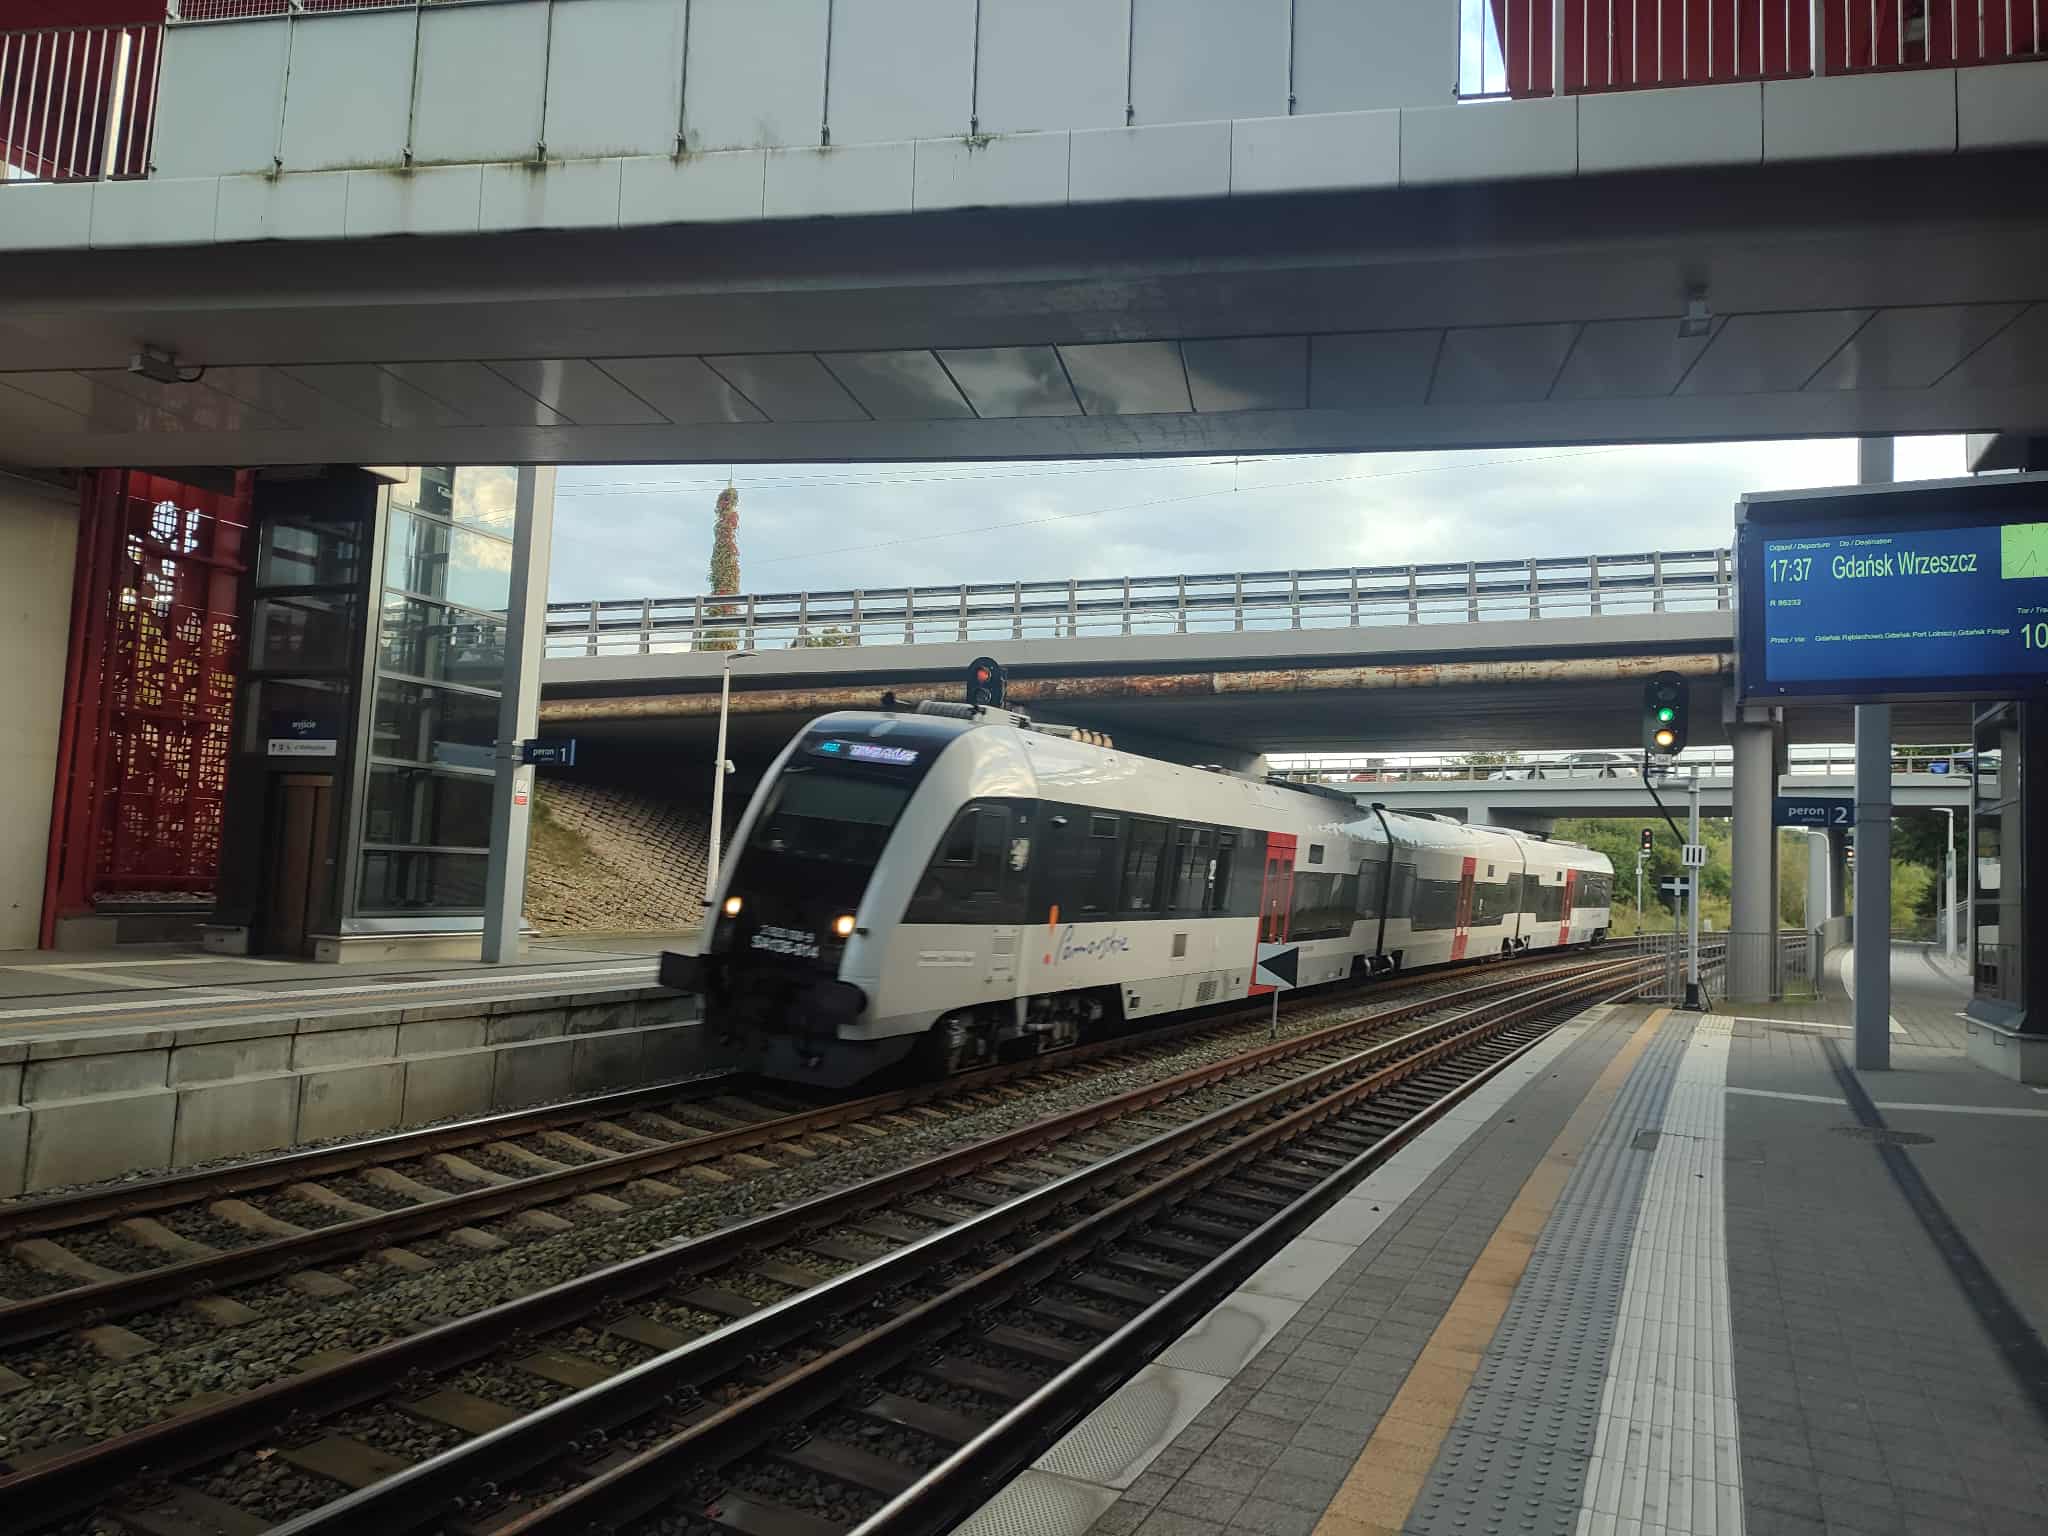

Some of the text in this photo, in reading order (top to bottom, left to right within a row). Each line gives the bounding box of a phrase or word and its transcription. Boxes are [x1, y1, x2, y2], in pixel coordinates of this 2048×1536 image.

[1770, 557, 1812, 583] 17:37
[1832, 551, 1978, 579] Gdańsk Wrzeszcz
[2020, 622, 2048, 649] 10
[559, 747, 566, 762] 1
[1788, 807, 1824, 817] peron
[1833, 806, 1849, 824] 2
